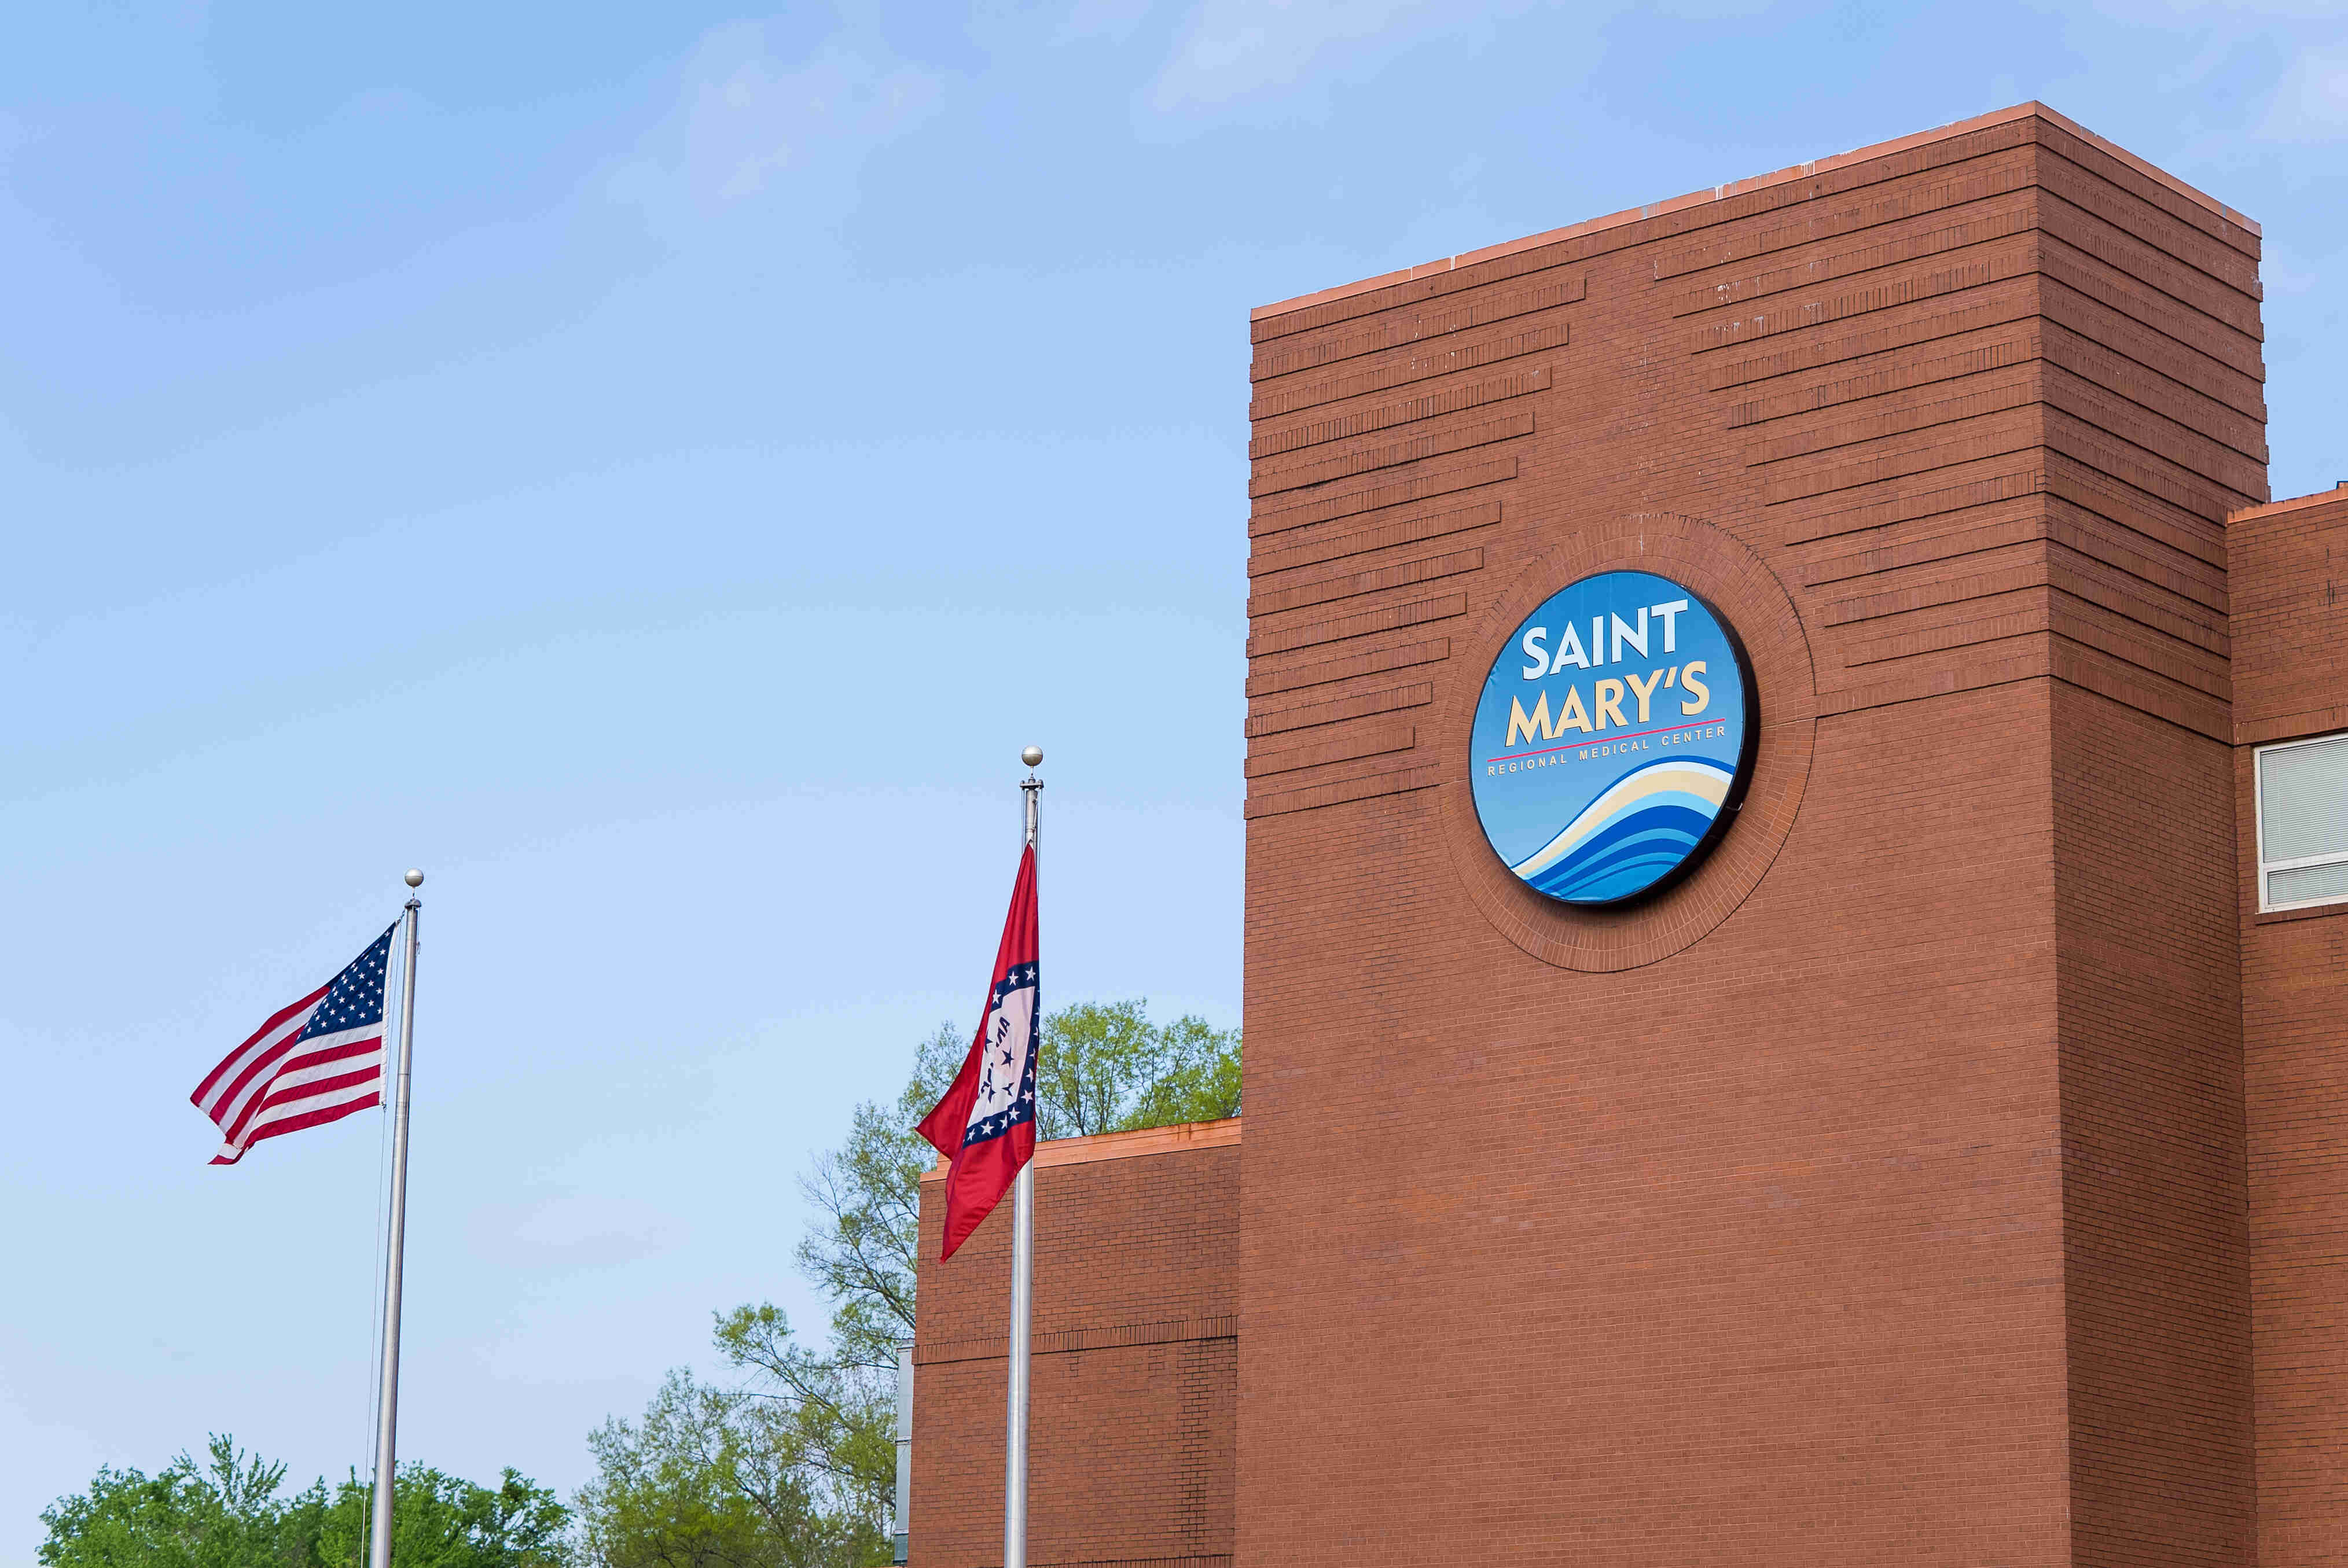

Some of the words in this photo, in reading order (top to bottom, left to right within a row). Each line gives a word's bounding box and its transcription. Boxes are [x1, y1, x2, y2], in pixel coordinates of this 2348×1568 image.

[1522, 599, 1688, 680] SAINT
[1504, 661, 1710, 748] MARY'S
[1487, 754, 1567, 776] REGIONAL
[1578, 739, 1649, 761] MEDICAL
[1660, 726, 1725, 746] CENTER
